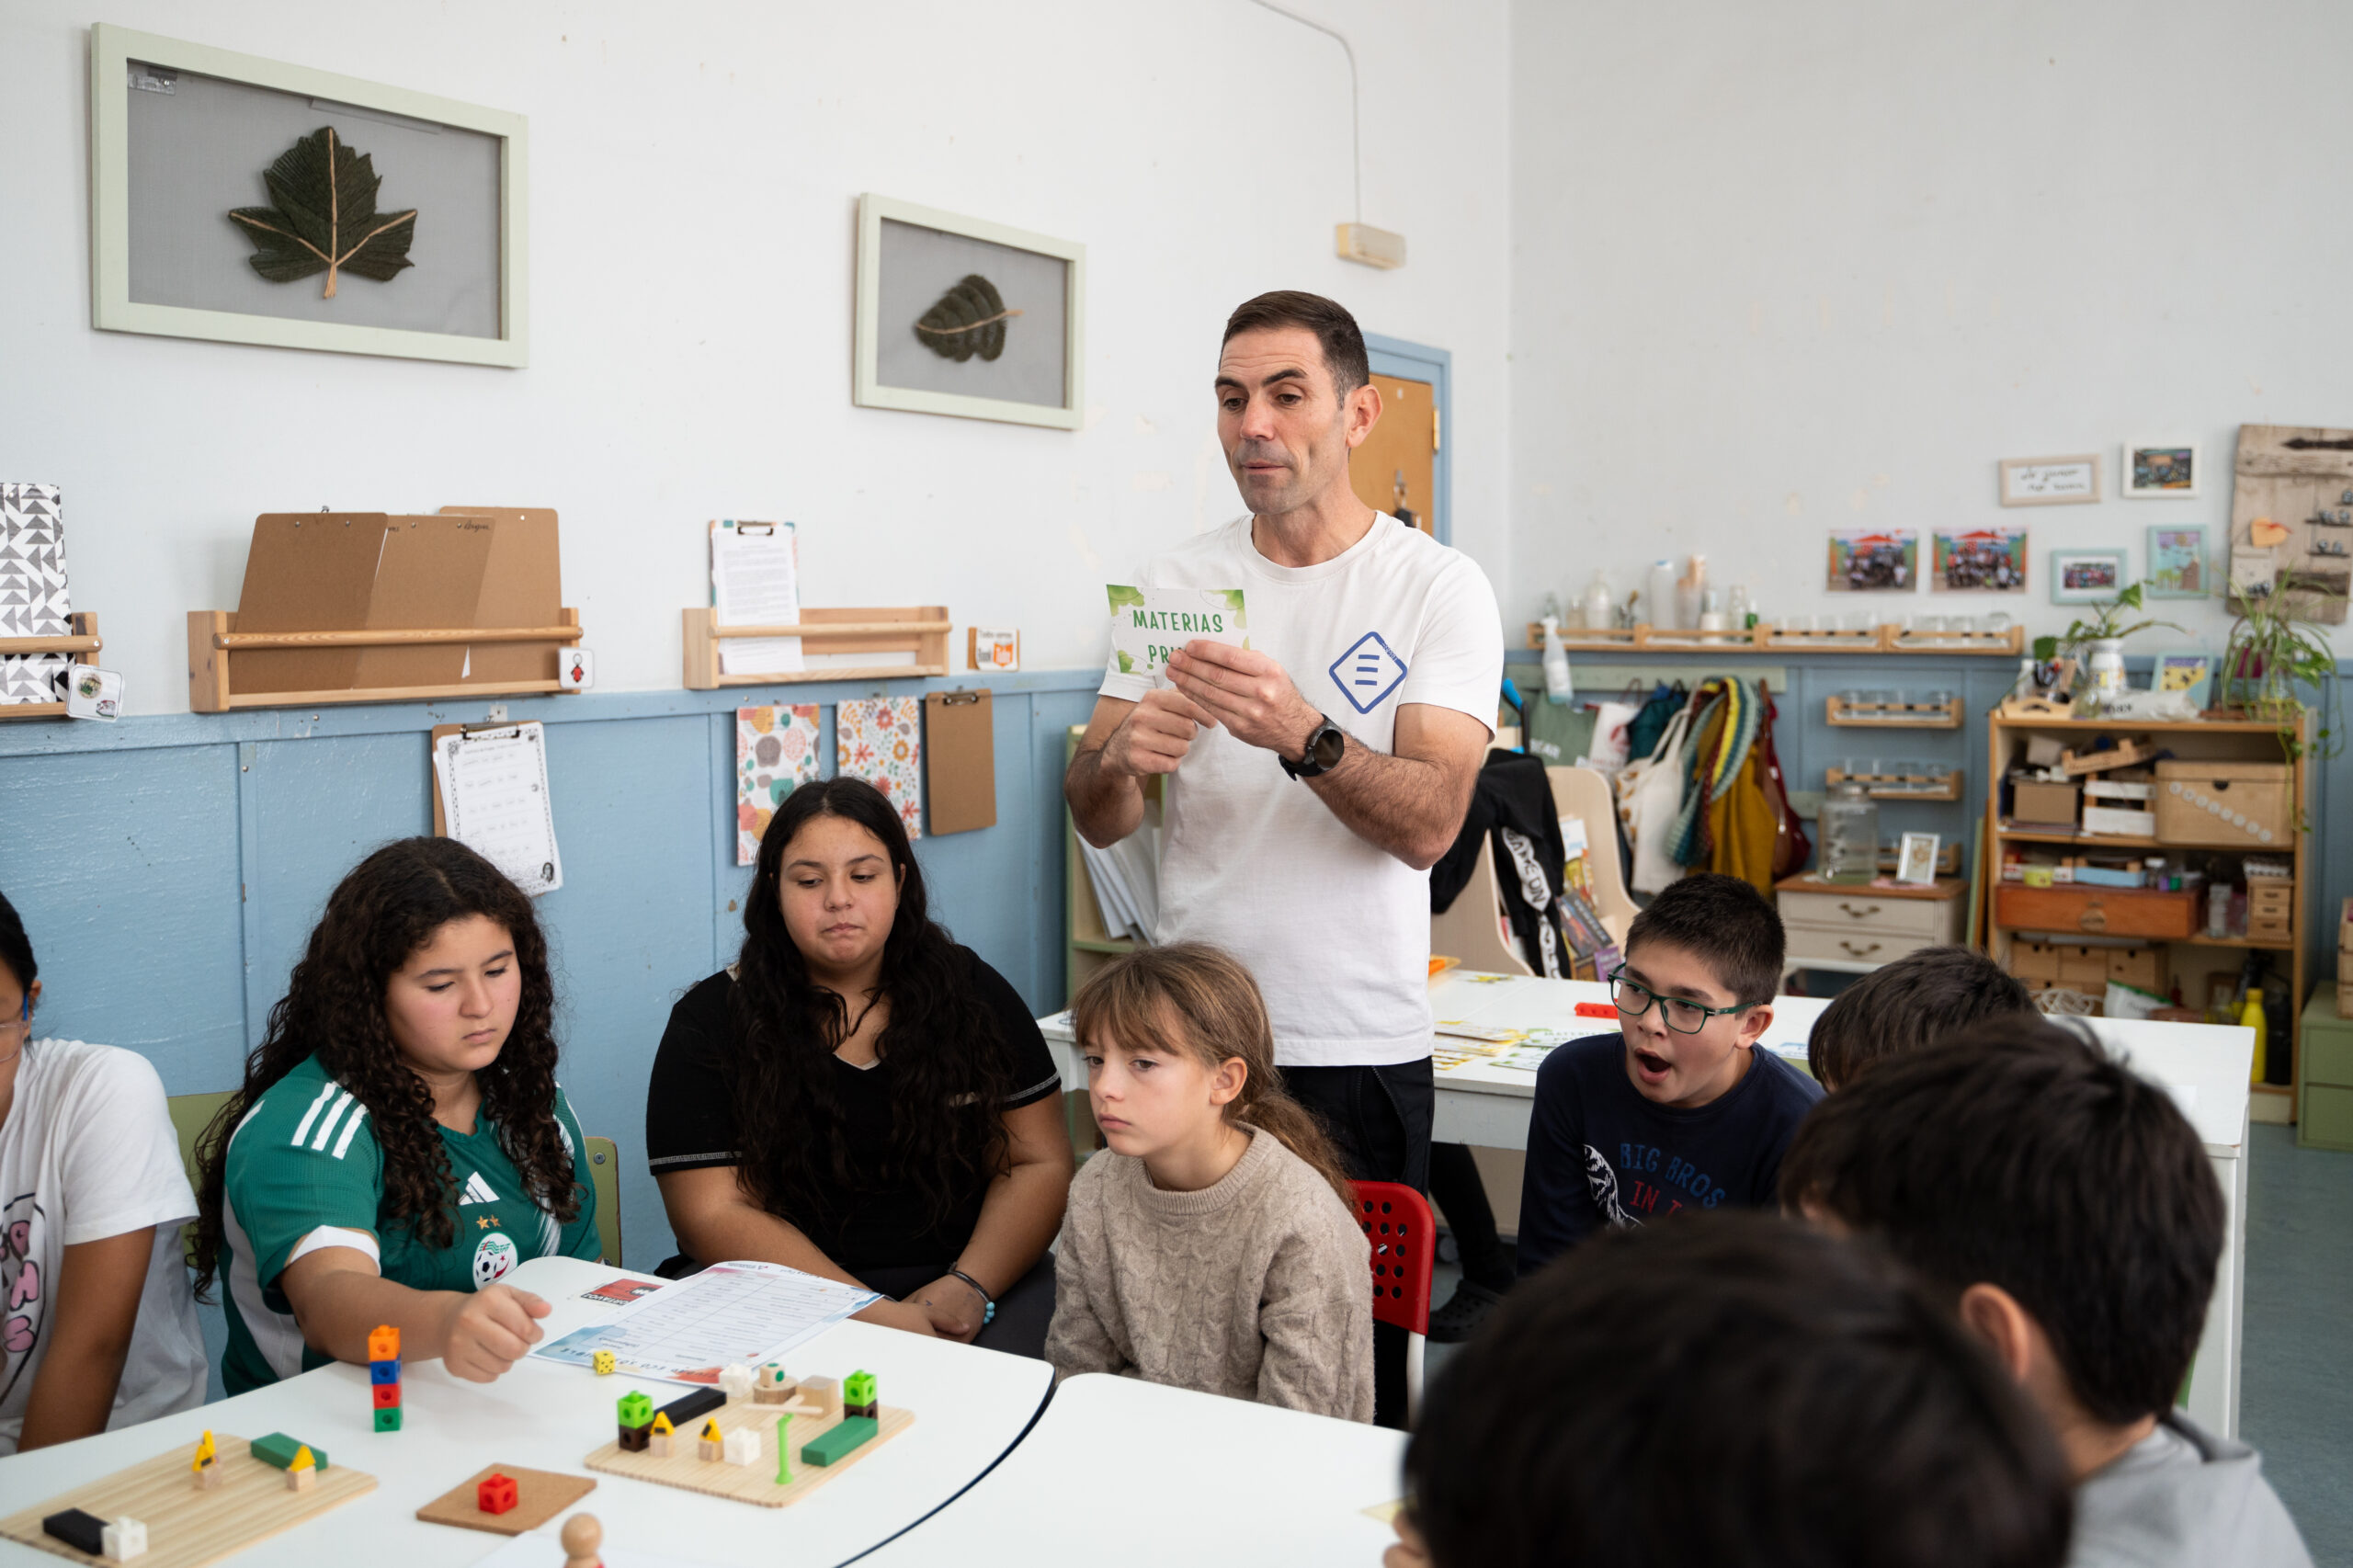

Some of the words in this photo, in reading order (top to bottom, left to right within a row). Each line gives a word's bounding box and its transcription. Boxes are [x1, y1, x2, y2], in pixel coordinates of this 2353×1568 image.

[1132, 609, 1223, 633] MATERIAS
[1148, 644, 1182, 664] PR
[1620, 1142, 1661, 1174] BIG
[1665, 1156, 1725, 1210] BROS
[1629, 1180, 1661, 1213] IN
[1666, 1199, 1683, 1217] T
[582, 1291, 629, 1305] ORTAVOZ
